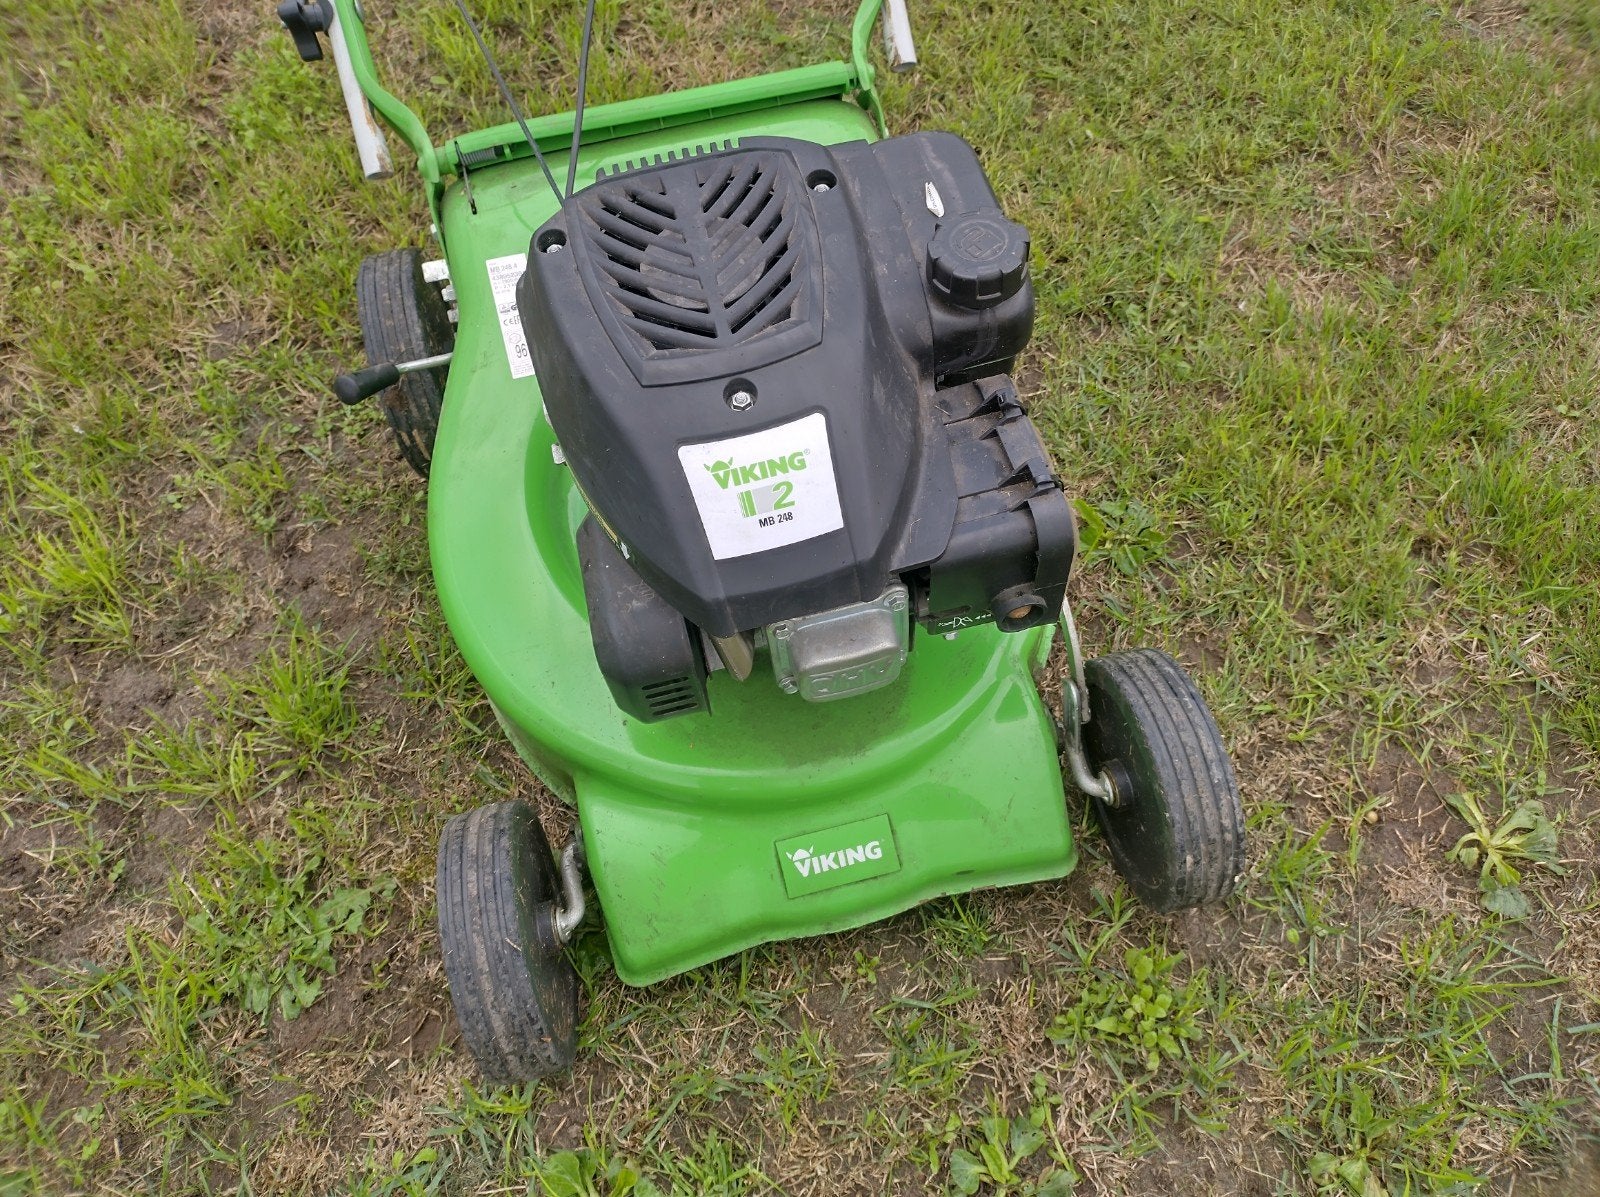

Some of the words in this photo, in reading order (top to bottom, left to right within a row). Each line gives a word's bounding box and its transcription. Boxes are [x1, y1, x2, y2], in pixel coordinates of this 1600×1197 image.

[515, 343, 528, 359] 96
[711, 450, 808, 491] VIKING
[758, 515, 775, 528] MB
[777, 511, 794, 525] 248
[793, 840, 883, 878] VIKING
